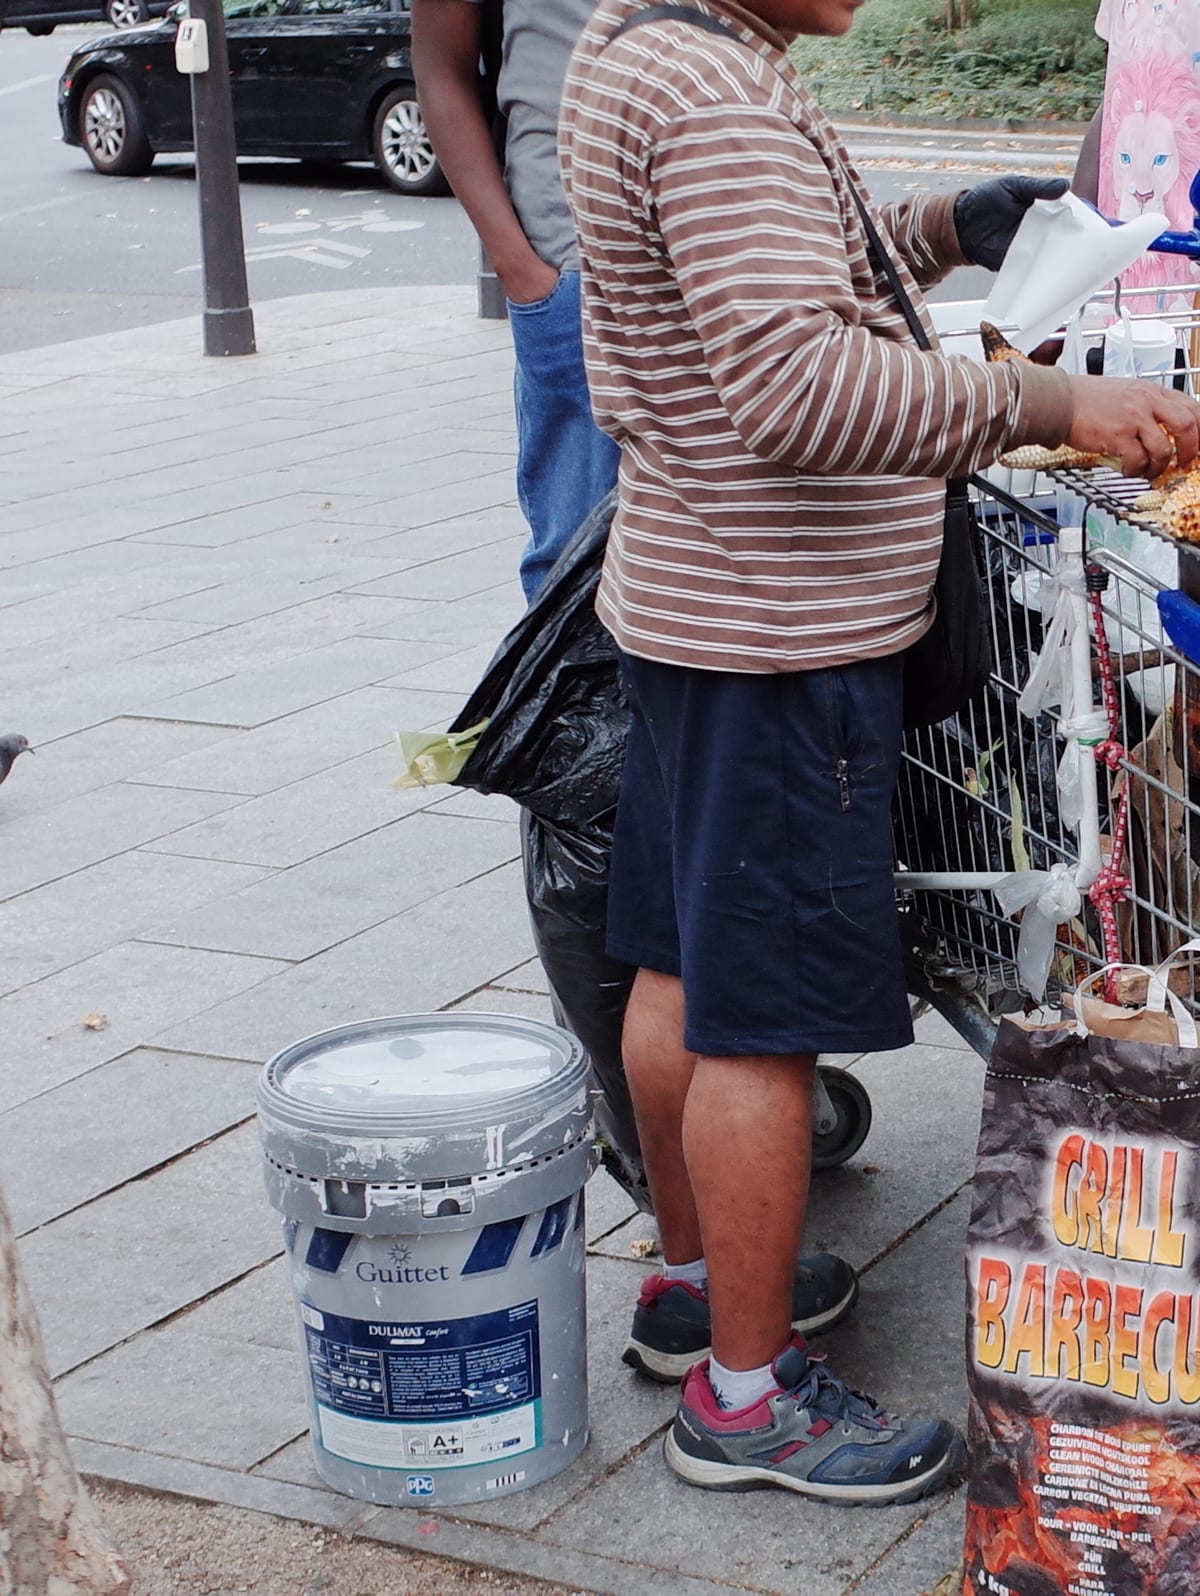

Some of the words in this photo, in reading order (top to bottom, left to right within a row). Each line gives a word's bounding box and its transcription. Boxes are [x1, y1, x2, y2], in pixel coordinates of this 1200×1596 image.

[1052, 1134, 1185, 1268] GRILL
[356, 1261, 449, 1283] Guittet
[368, 1325, 423, 1337] DULIMAT
[1050, 1424, 1094, 1438] CHARBON
[433, 1434, 459, 1448] A+
[1050, 1449, 1080, 1460] CLEAN
[1082, 1453, 1104, 1467] WOOD
[1105, 1461, 1148, 1477] CHARCOAL
[1102, 1445, 1151, 1465] HOUTSKOOL
[408, 1477, 433, 1494] PPG
[1044, 1474, 1088, 1488] CARBONE
[1124, 1491, 1150, 1503] PURA
[1071, 1491, 1108, 1507] VEGETAL
[1109, 1500, 1161, 1515] PURIFICADO
[1038, 1516, 1063, 1529] POUR
[1072, 1521, 1099, 1534] VOOR
[1106, 1527, 1123, 1540] FOR
[1131, 1532, 1151, 1543] PER
[1070, 1532, 1118, 1549] BARBECUE
[1083, 1550, 1102, 1564] FÜR
[1077, 1562, 1106, 1576] GRILL
[988, 1574, 1010, 1596] kg
[1079, 1578, 1105, 1591] PARA
